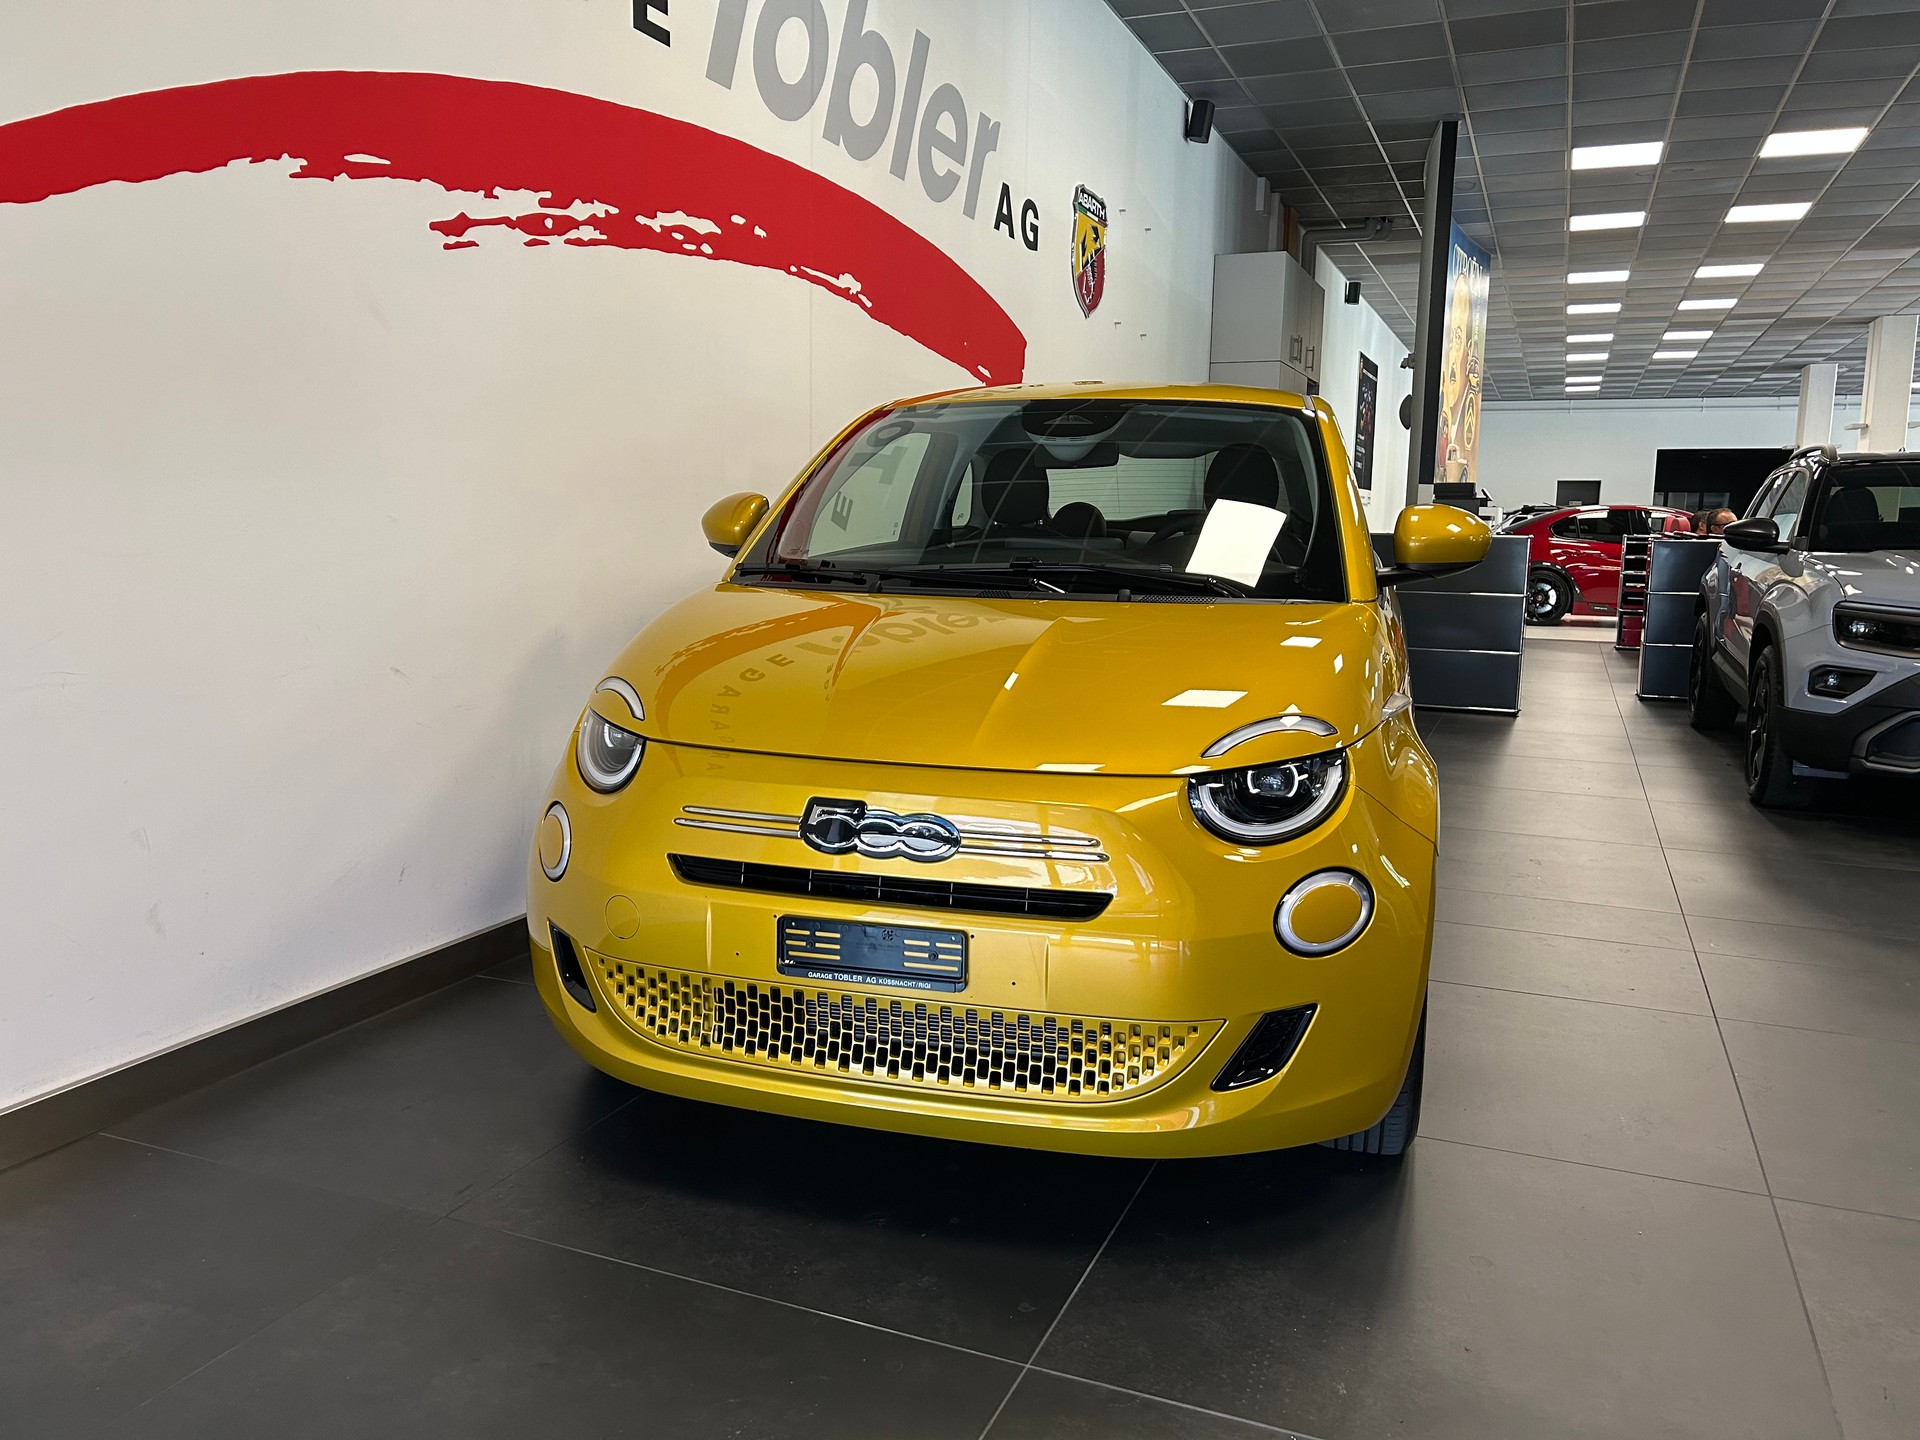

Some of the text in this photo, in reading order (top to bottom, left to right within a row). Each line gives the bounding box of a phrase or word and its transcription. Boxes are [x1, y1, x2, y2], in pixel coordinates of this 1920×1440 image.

[994, 182, 1039, 251] AG
[1079, 192, 1105, 219] ABARTH
[801, 796, 960, 863] 500
[808, 971, 833, 980] GARAGE
[834, 973, 863, 982] TOBLER
[866, 976, 877, 984] AG
